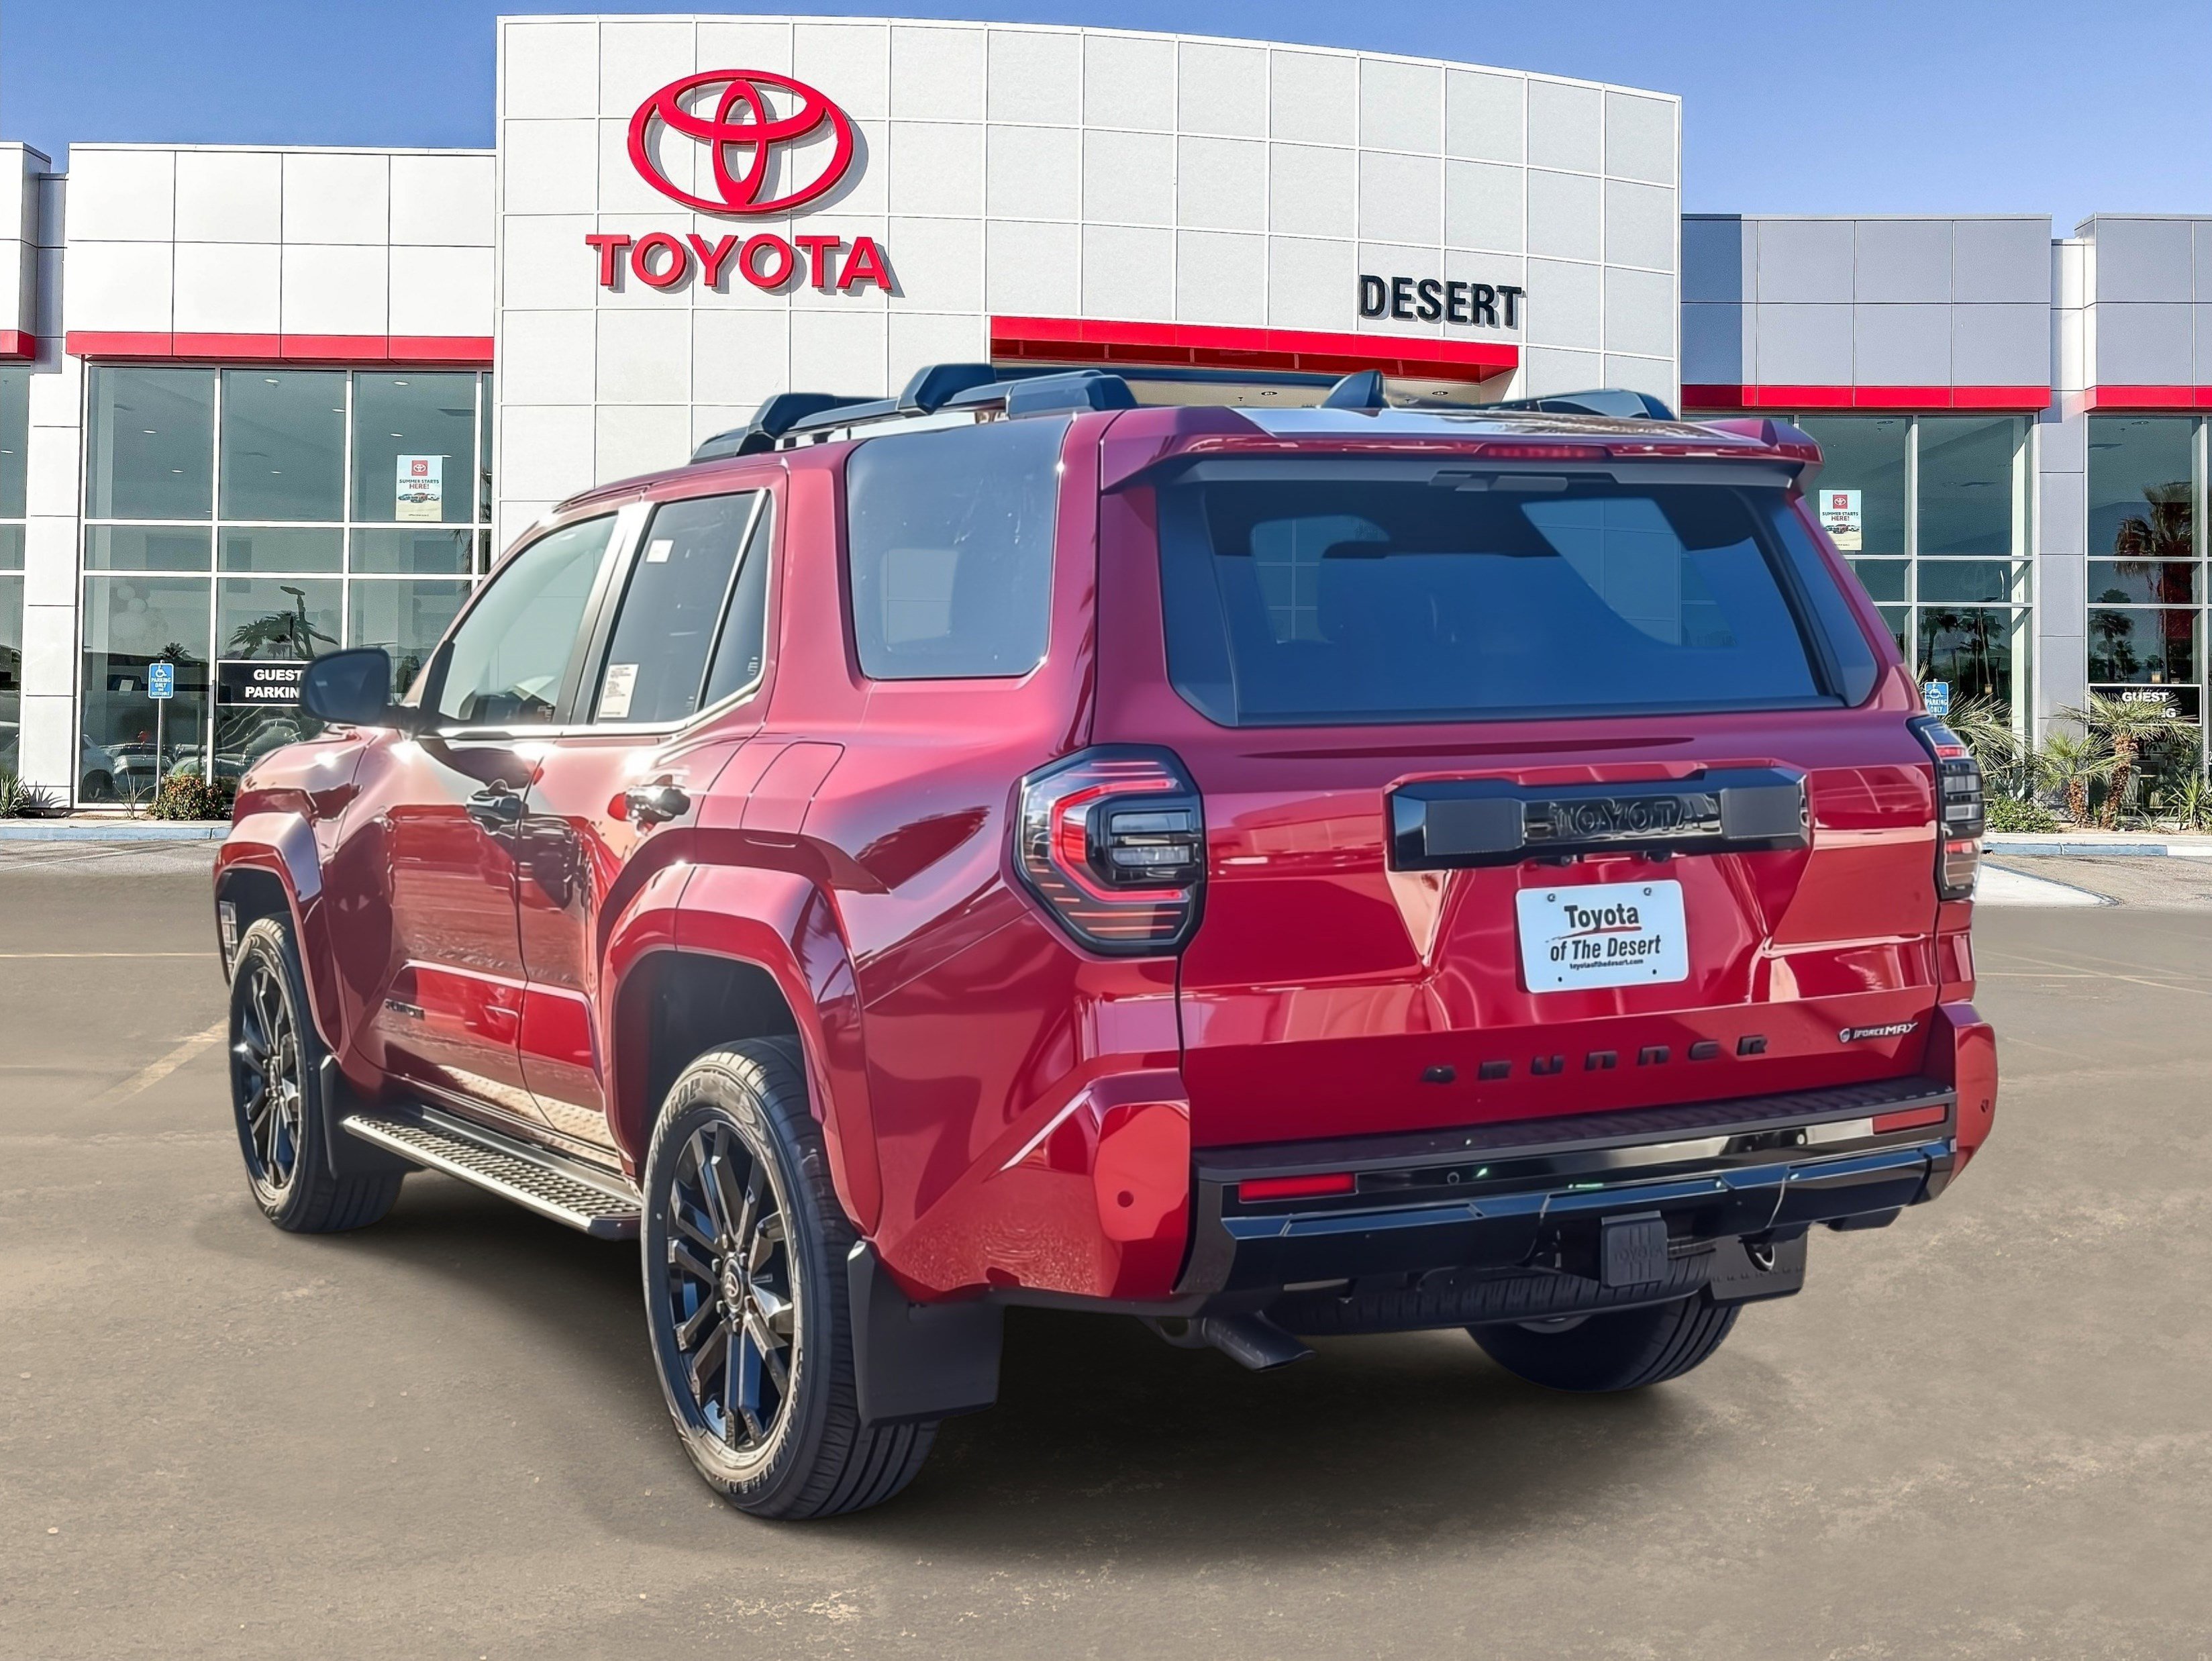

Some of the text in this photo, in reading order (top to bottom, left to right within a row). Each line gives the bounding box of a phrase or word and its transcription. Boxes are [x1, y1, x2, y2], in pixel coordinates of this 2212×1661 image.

[586, 232, 893, 290] TOYOTA
[1359, 274, 1522, 326] DESERT
[253, 668, 304, 681] GUEST
[245, 686, 300, 698] PARKIN
[2121, 692, 2169, 703] GUEST
[1564, 903, 1640, 932] Toyota
[1550, 934, 1662, 962] of The Desert
